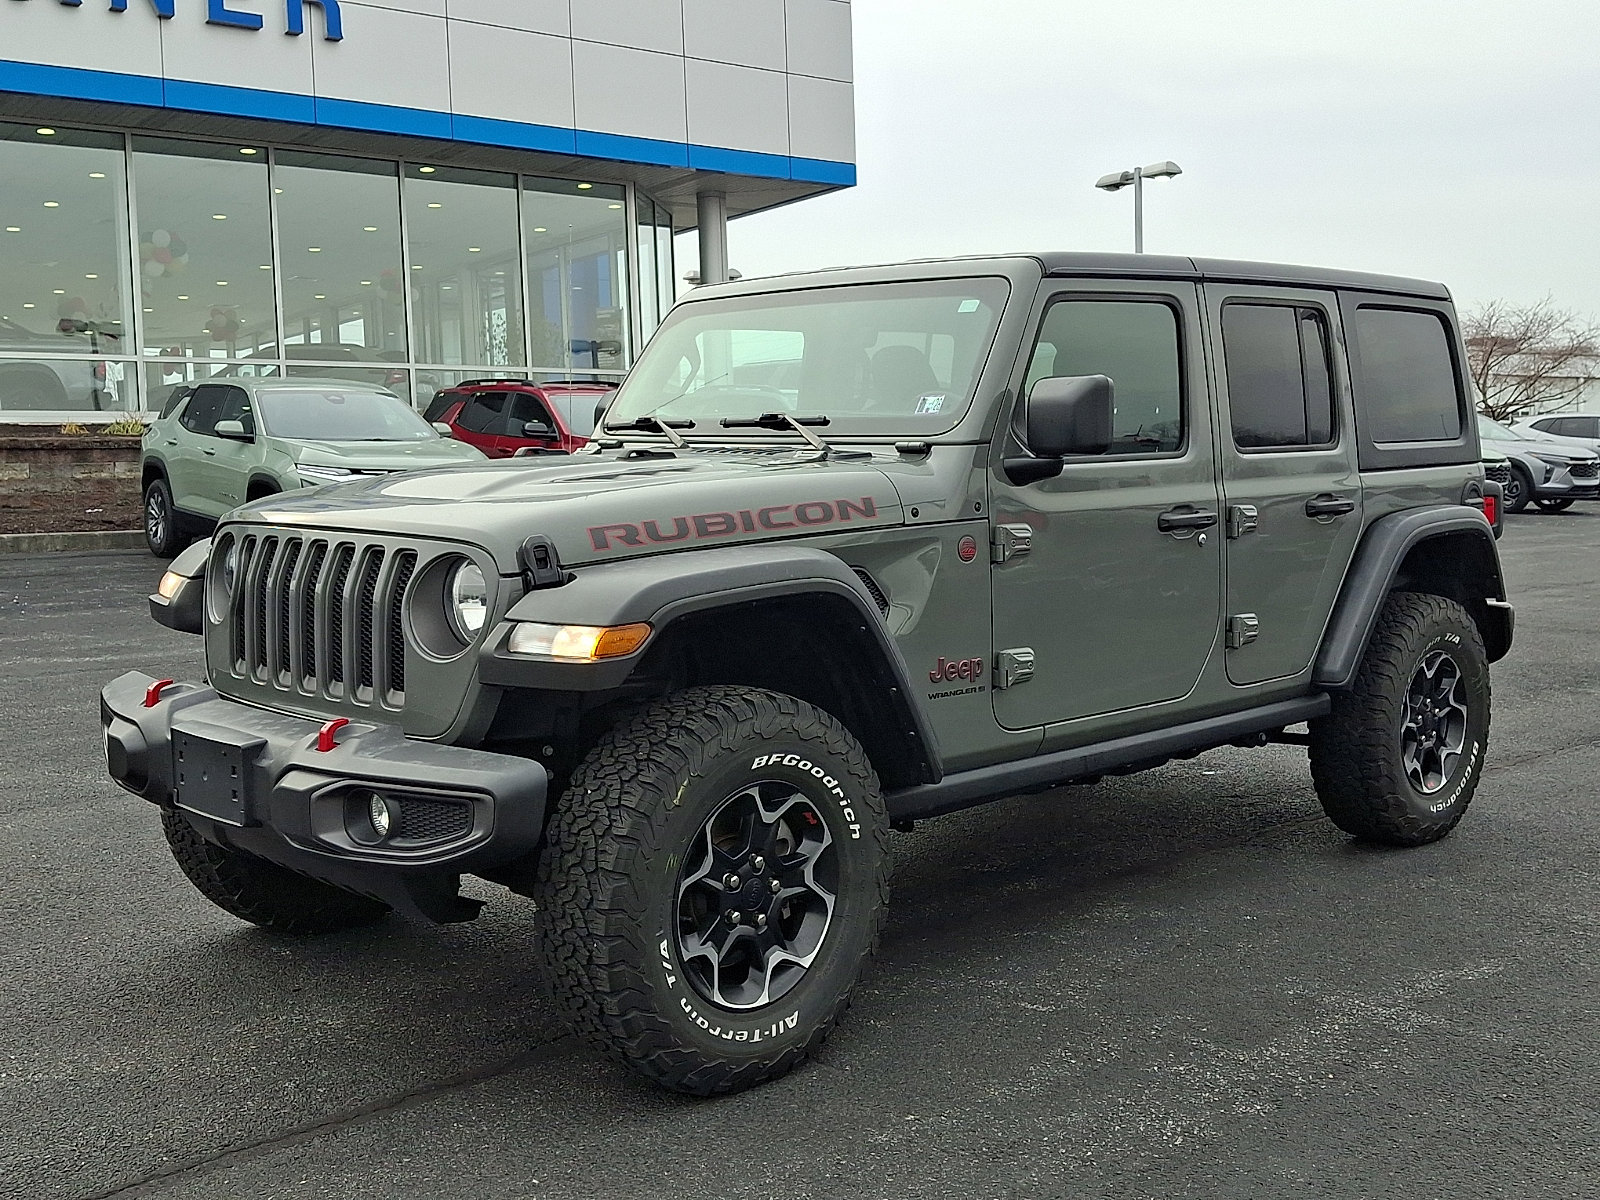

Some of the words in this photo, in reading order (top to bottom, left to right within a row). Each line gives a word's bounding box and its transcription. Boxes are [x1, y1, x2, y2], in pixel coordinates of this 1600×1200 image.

[587, 497, 878, 551] RUBICON
[1444, 632, 1460, 644] T/A
[928, 686, 977, 700] WRANGLER
[930, 656, 984, 683] Jeep
[751, 754, 860, 839] BFGoodrich
[1430, 740, 1479, 813] BFGoodrich
[659, 938, 677, 989] T/A
[680, 998, 799, 1043] All-Terrain
